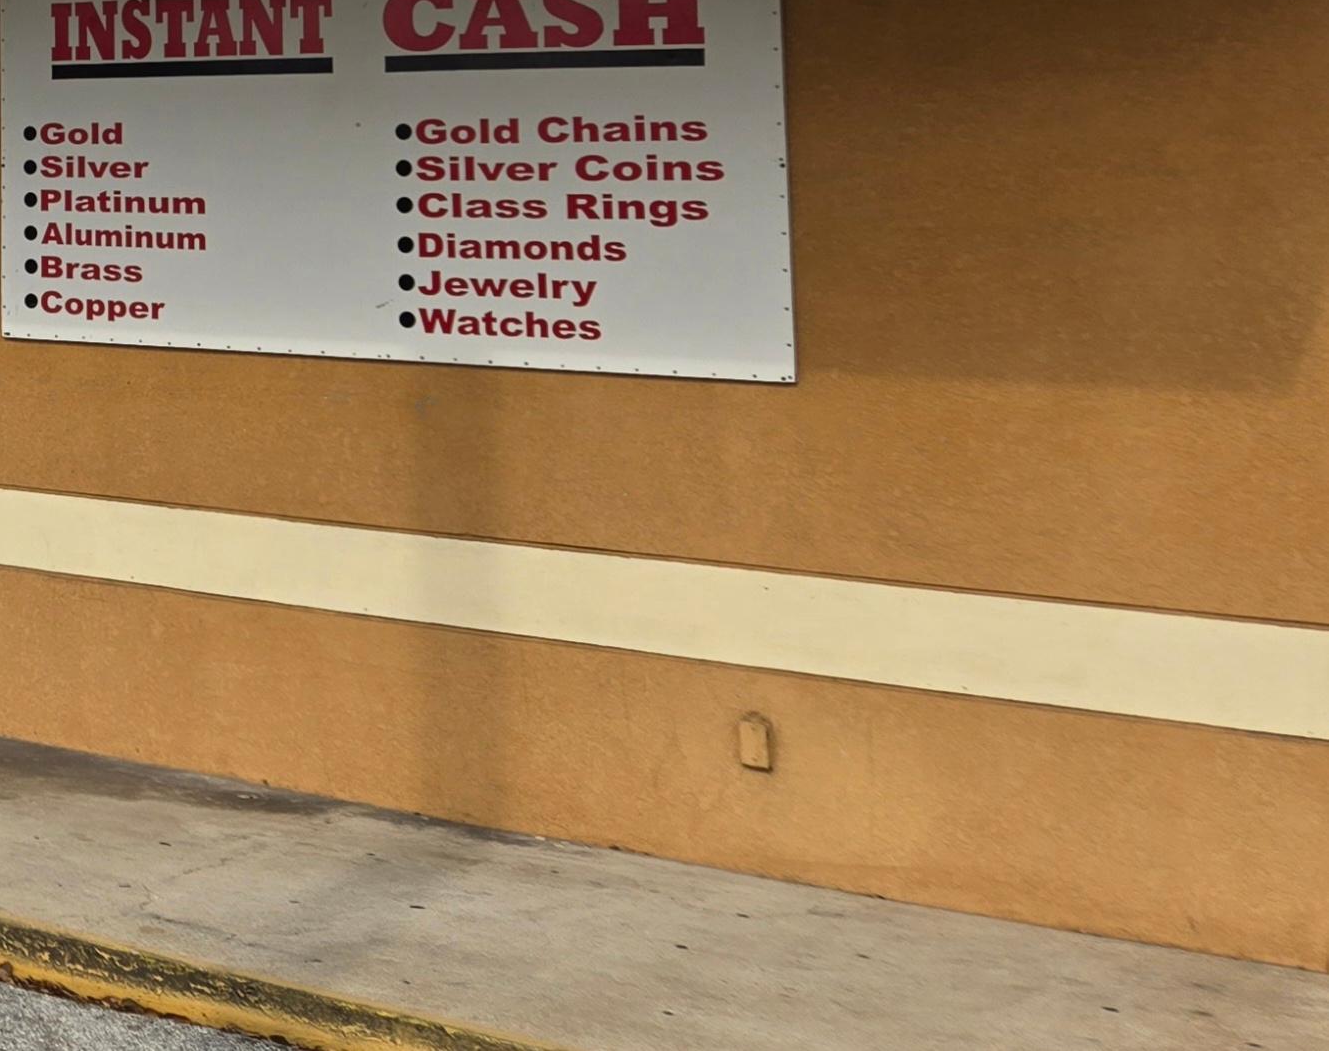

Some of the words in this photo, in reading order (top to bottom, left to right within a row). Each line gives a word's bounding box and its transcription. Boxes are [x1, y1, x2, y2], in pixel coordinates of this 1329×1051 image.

[39, 121, 124, 147] Gold
[414, 116, 521, 146] Gold
[536, 115, 710, 145] Chains
[40, 155, 149, 181] Silver
[415, 155, 559, 183] Silver
[573, 153, 725, 183] Coins
[39, 188, 207, 215] Platinum
[417, 191, 549, 220] Class
[565, 192, 710, 229] Rings
[41, 221, 208, 252] Aluminum
[417, 231, 627, 263] Diamonds
[39, 254, 144, 284] Brass
[418, 270, 598, 309] Jewelry
[39, 289, 165, 323] Copper
[419, 305, 603, 342] Watches
